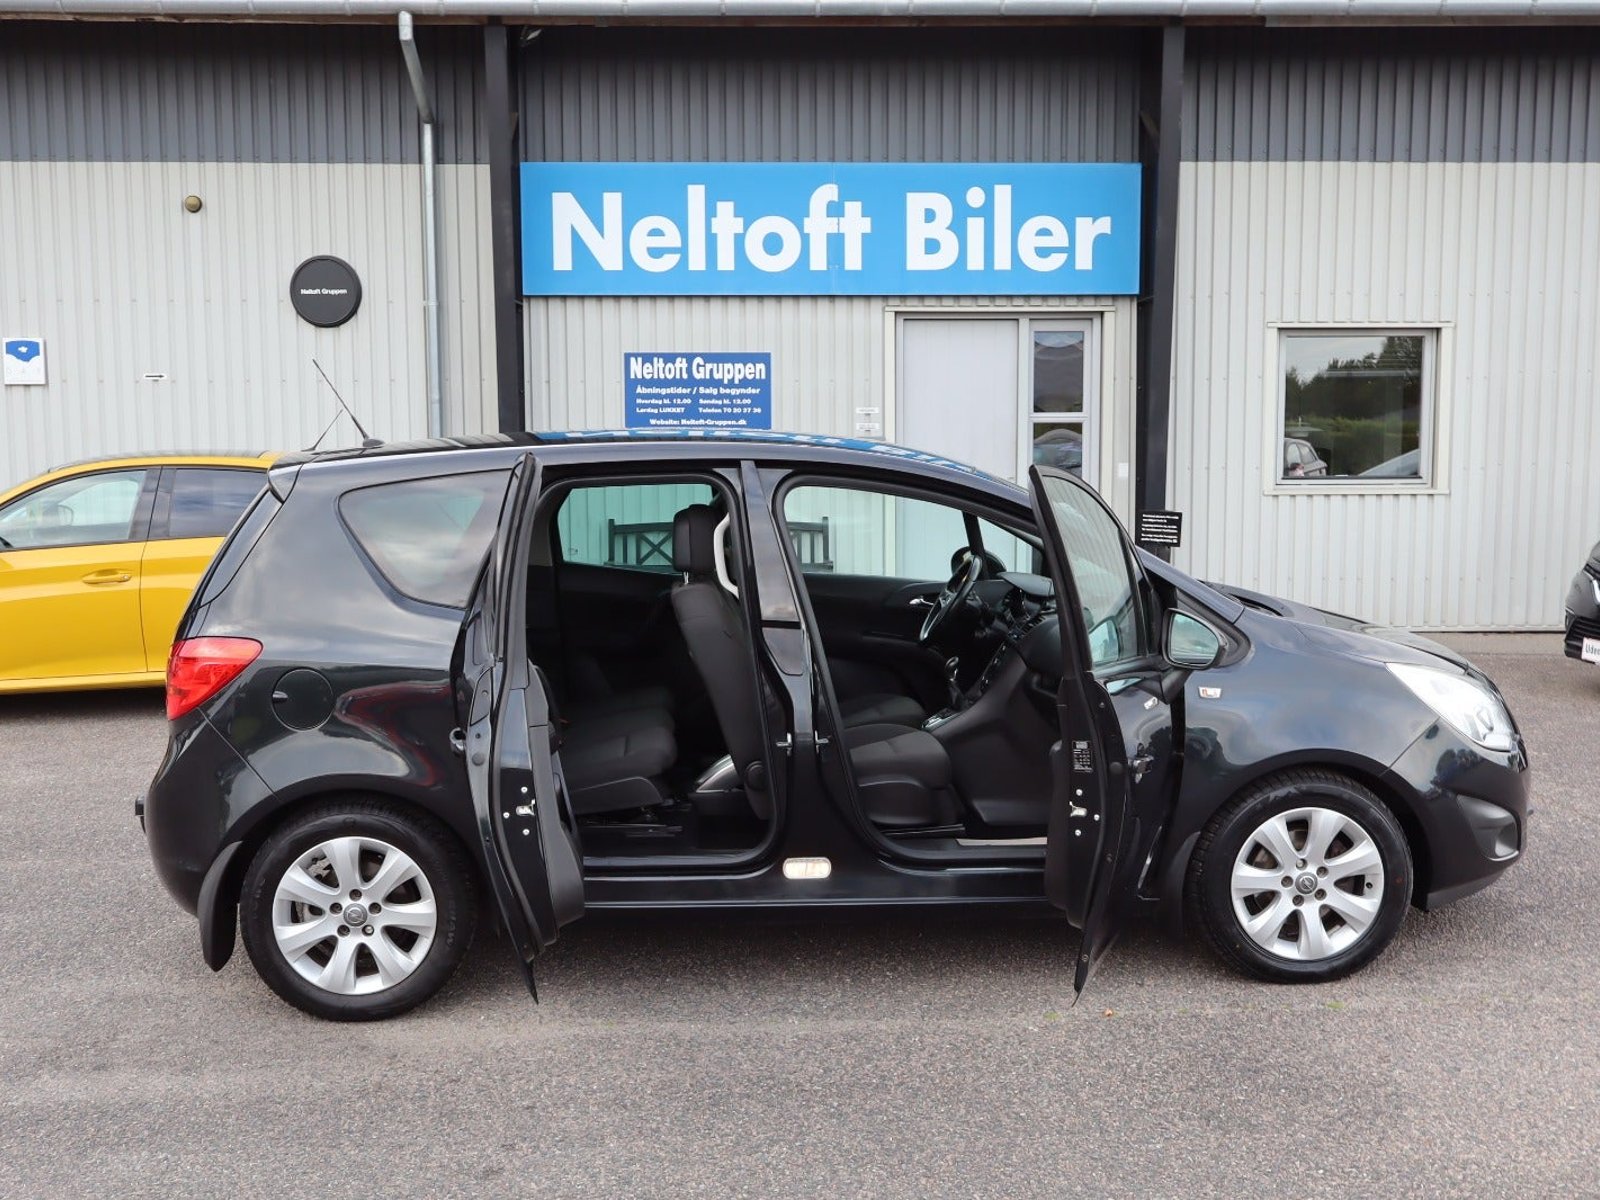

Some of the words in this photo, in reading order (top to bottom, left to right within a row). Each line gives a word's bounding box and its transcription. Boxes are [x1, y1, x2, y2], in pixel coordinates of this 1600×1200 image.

[553, 184, 871, 272] Neltoft
[907, 184, 1111, 272] Biler
[321, 288, 347, 296] Gruppen
[630, 356, 688, 380] Neltoft
[692, 356, 766, 384] Gruppen
[636, 384, 691, 395] Åbningstider
[699, 386, 718, 396] Salg
[719, 386, 760, 396] begynder
